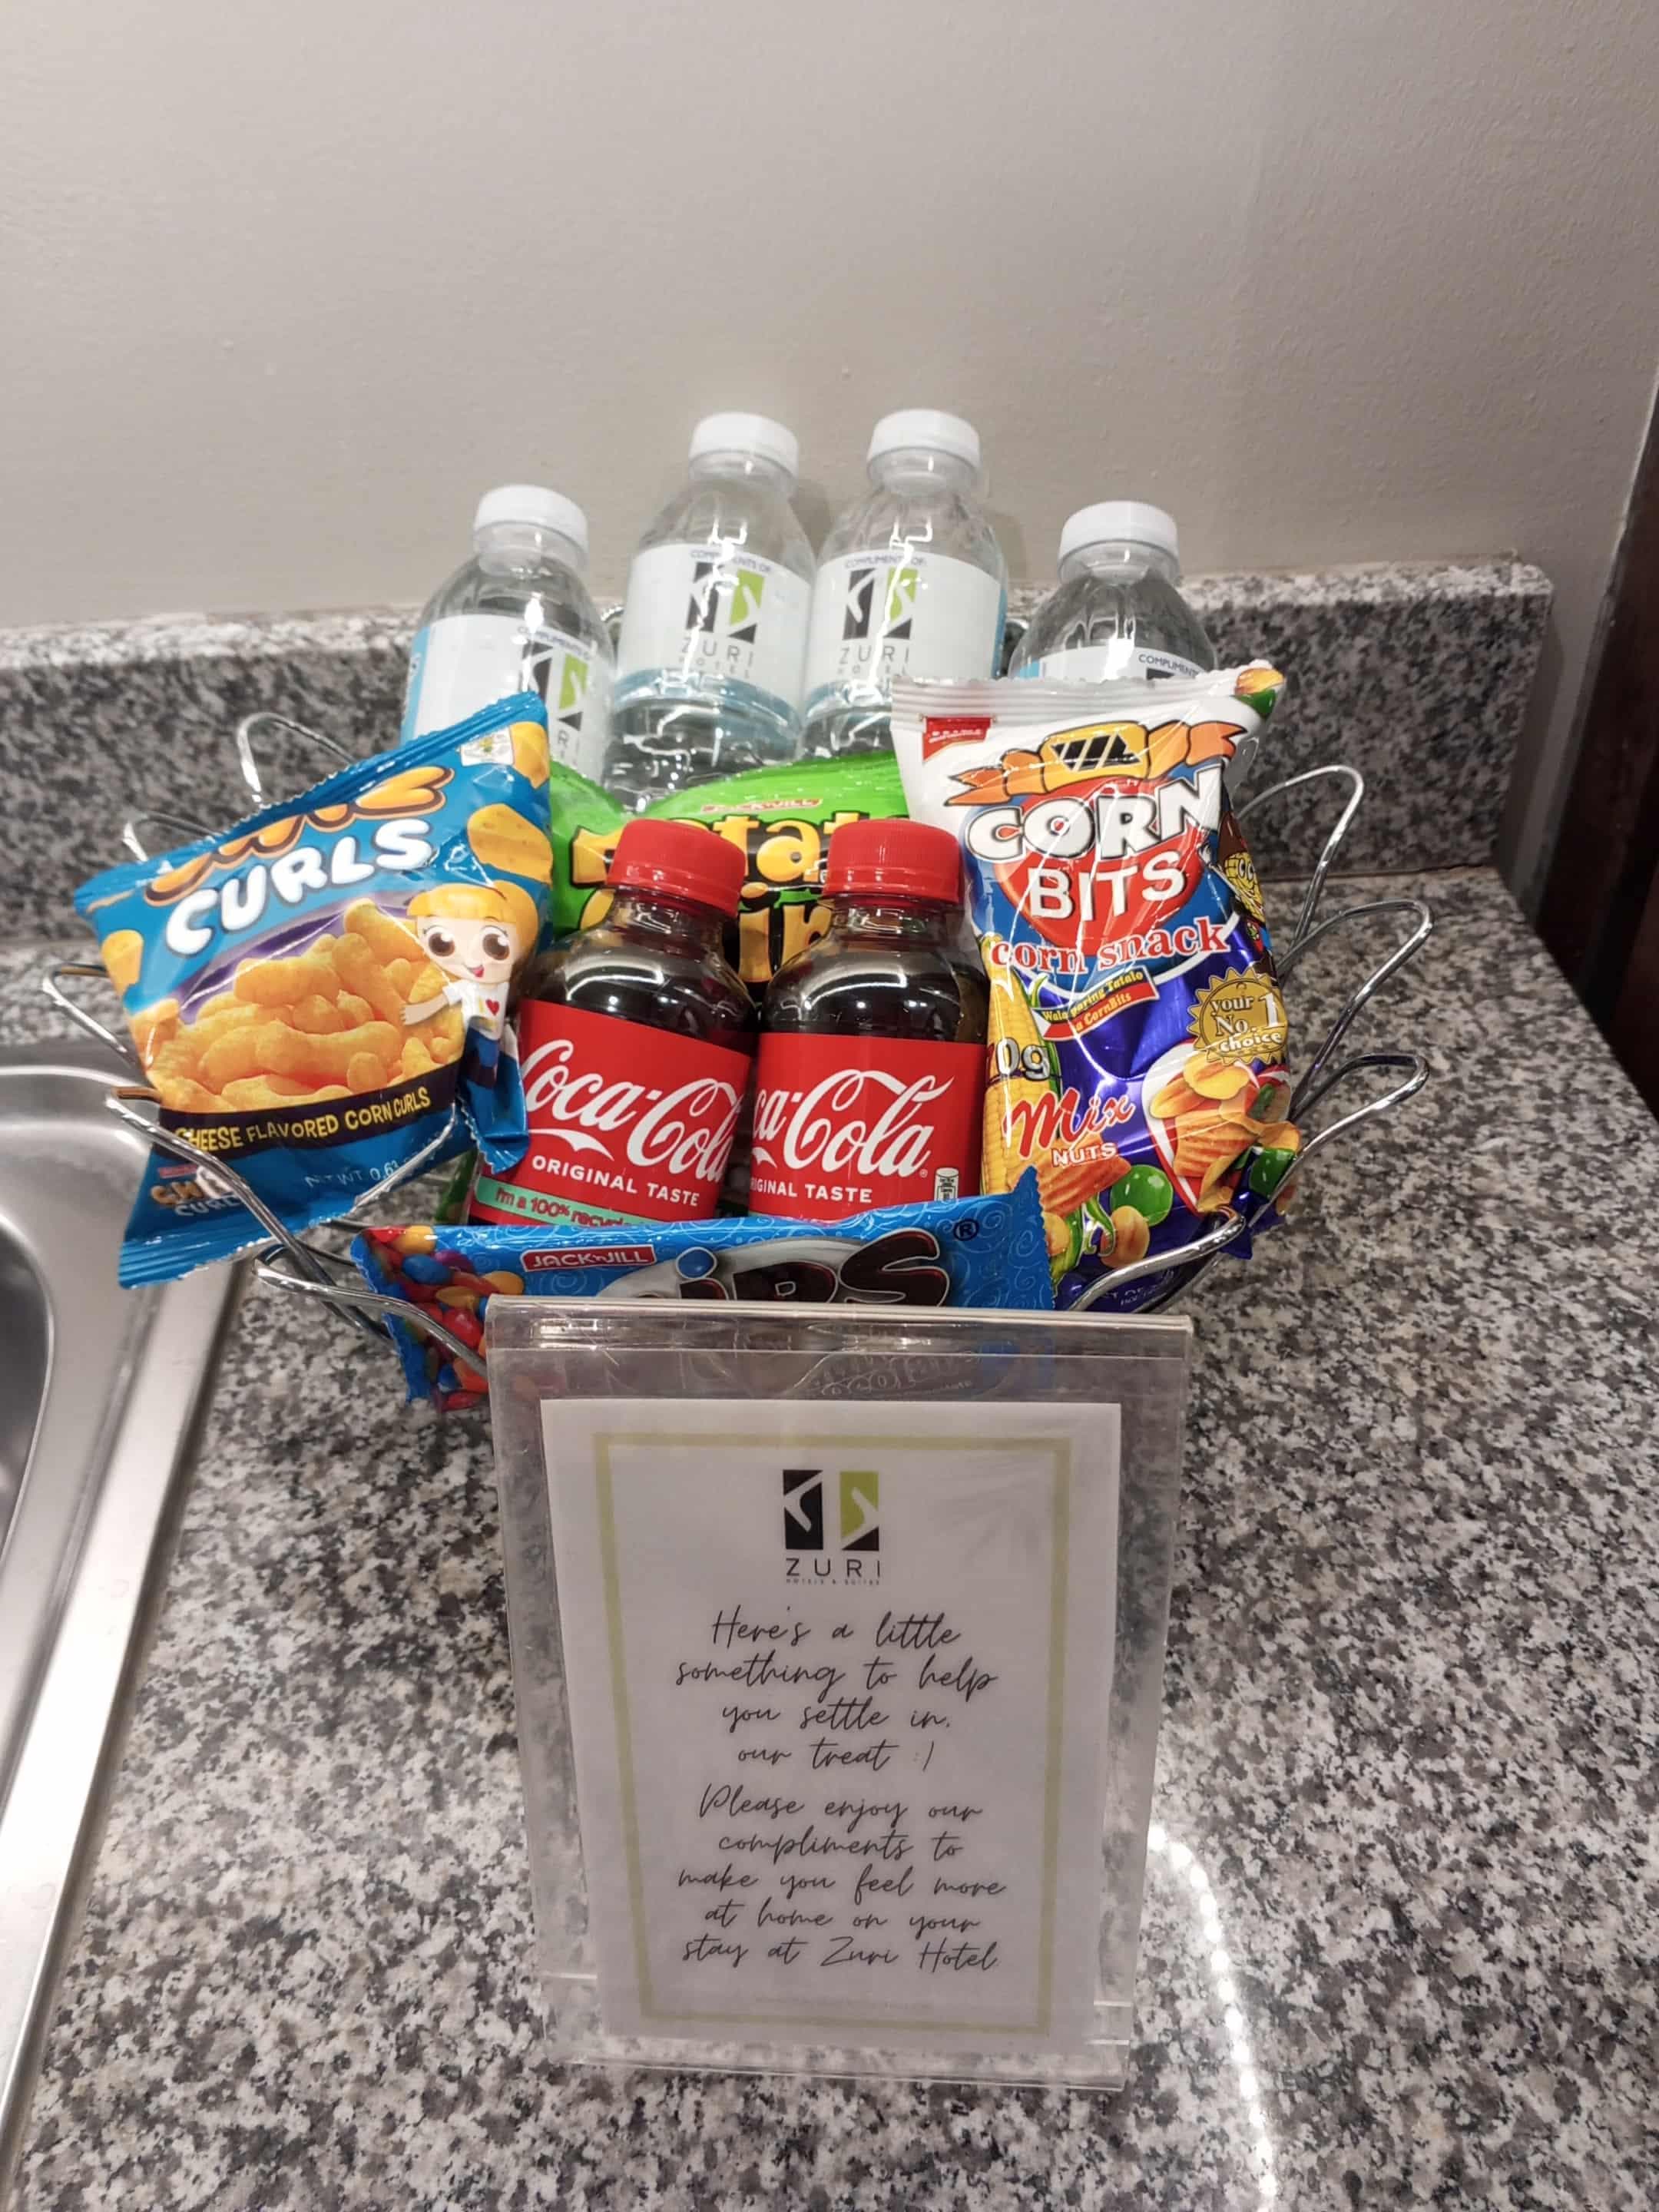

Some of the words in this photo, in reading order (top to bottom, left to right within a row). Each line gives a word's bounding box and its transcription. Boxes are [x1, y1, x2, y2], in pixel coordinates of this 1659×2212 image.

[680, 637, 755, 668] ZURI
[839, 644, 910, 665] ZURI
[1138, 654, 1200, 680] COMPLIMENT
[966, 764, 1227, 863] CORN
[166, 819, 431, 956] CURLS
[1028, 849, 1187, 922] BITS
[991, 937, 1088, 975] corn
[1096, 916, 1231, 972] snack
[1084, 992, 1132, 1025] CornBits
[1211, 993, 1254, 1016] your
[1219, 1032, 1283, 1055] choice
[176, 1126, 243, 1152] CHEESE
[247, 1114, 339, 1143] FLAVORED
[344, 1104, 392, 1130] CORN
[392, 1087, 432, 1114] CURLS
[752, 1069, 955, 1177] ca-Cola
[1002, 1088, 1136, 1160] Mix
[1051, 1142, 1118, 1167] NUTS
[531, 1154, 637, 1194] ORIGINAL
[647, 1183, 700, 1207] TASTE
[750, 1175, 798, 1197] RIGINAL
[805, 1184, 873, 1204] TASTE
[174, 1194, 240, 1217] CURL
[517, 1197, 527, 1210] a
[530, 1197, 570, 1218] 100%
[786, 1558, 881, 1578] ZURI
[712, 1605, 811, 1649] Here's
[832, 1622, 853, 1641] a
[876, 1612, 961, 1649] little
[676, 1650, 846, 1703] something
[863, 1656, 897, 1690] to
[919, 1654, 999, 1703] help
[723, 1704, 781, 1734] you
[800, 1696, 890, 1730] settle
[738, 1747, 792, 1763] our
[810, 1738, 899, 1771] treat
[699, 1783, 804, 1819] Please
[824, 1799, 909, 1833] enjoy
[929, 1805, 983, 1821] our
[718, 1825, 914, 1864] compliments
[932, 1834, 965, 1862] to
[678, 1864, 759, 1892] make
[780, 1874, 836, 1900] you
[854, 1867, 914, 1906] feel
[934, 1882, 1007, 1897] more
[704, 1903, 745, 1928] at
[758, 1897, 833, 1927] home
[853, 1915, 888, 1929] on
[909, 1915, 981, 1940] your
[682, 1933, 749, 1968] stay
[768, 1939, 810, 1965] at
[820, 1936, 899, 1967] Zuri
[919, 1936, 998, 1974] Hotel
